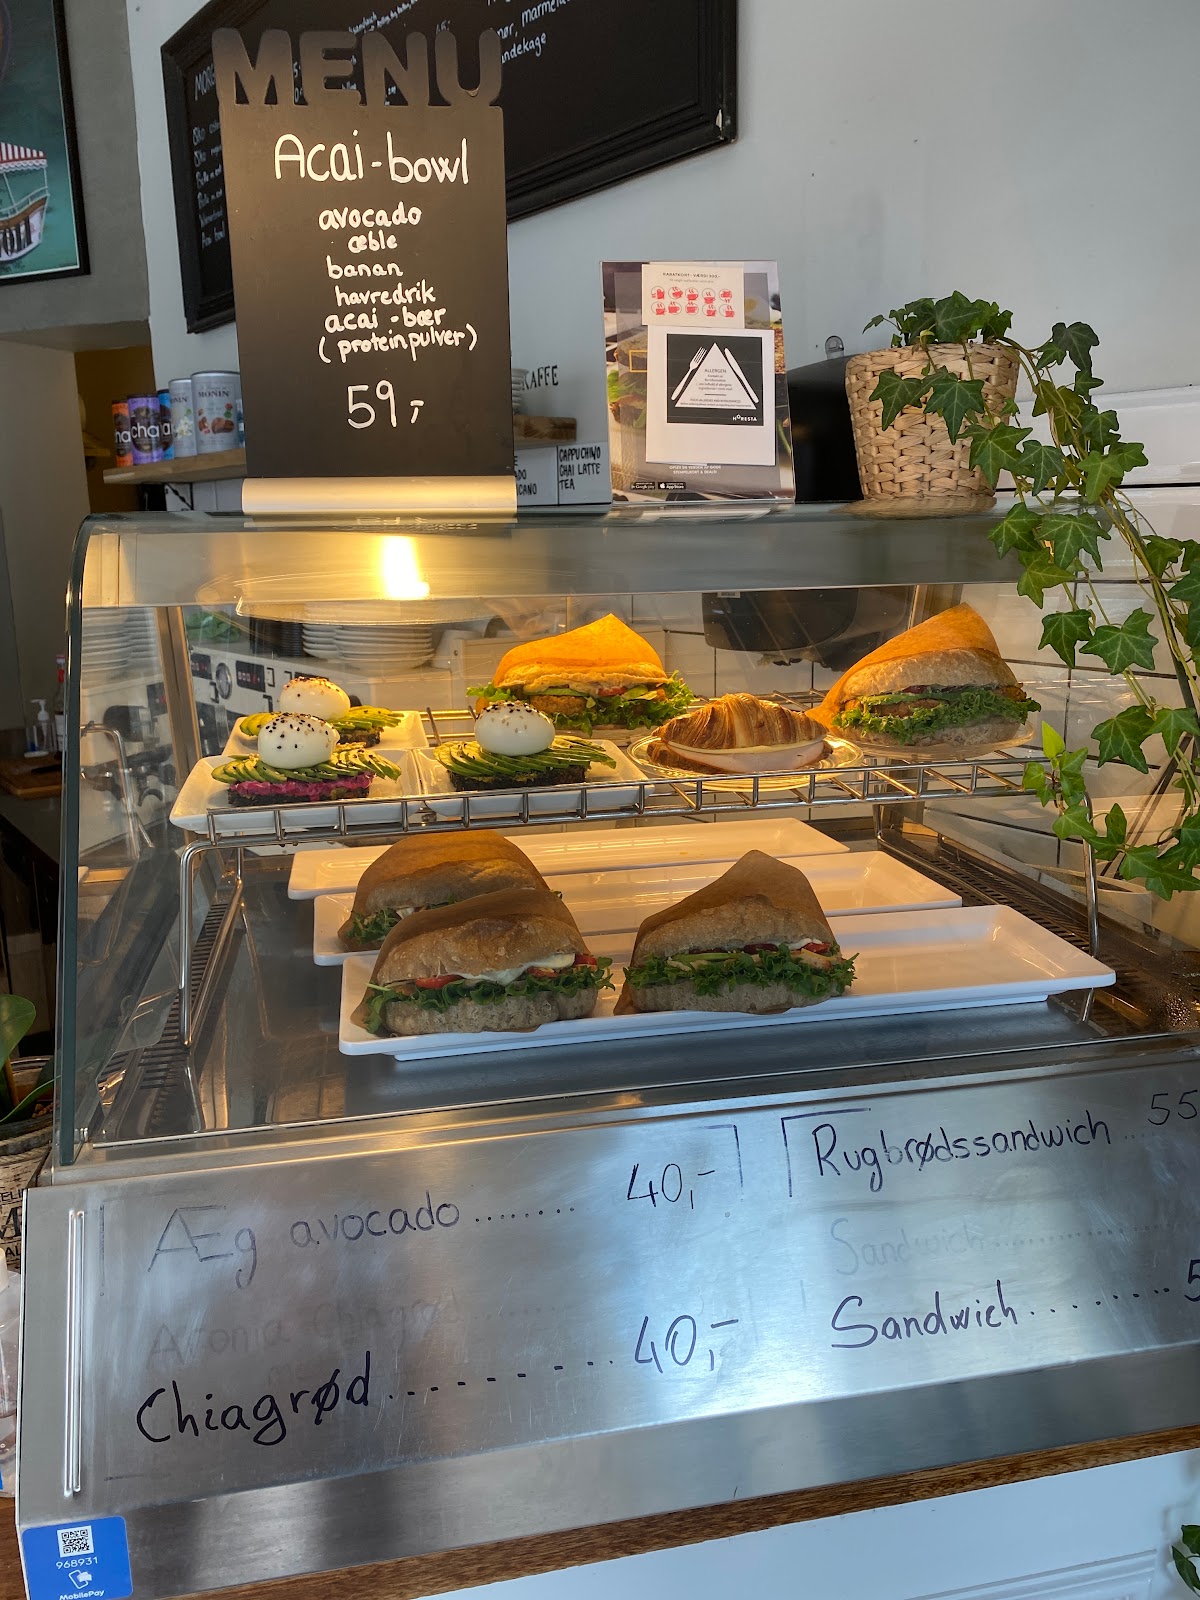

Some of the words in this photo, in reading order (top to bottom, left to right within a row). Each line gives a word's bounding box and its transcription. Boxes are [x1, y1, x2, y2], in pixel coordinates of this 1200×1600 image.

[211, 27, 503, 105] MENU
[318, 201, 422, 230] avocado
[348, 230, 398, 253] æble
[326, 255, 403, 279] banan
[334, 279, 436, 306] havredrik
[559, 463, 575, 478] CHAI
[577, 463, 601, 476] LATTE
[517, 483, 538, 496] CANO
[559, 478, 575, 491] TEA
[811, 1110, 1111, 1192] Rugbrødssandwich
[147, 1204, 257, 1289] Æg
[289, 1191, 461, 1248] avocado
[626, 1163, 716, 1210] 40,-
[831, 1280, 1018, 1349] Sandwich
[136, 1350, 372, 1445] Chiagrød
[634, 1313, 740, 1373] 40,-
[55, 1556, 99, 1570] 968931
[59, 1590, 105, 1600] MobilePay
